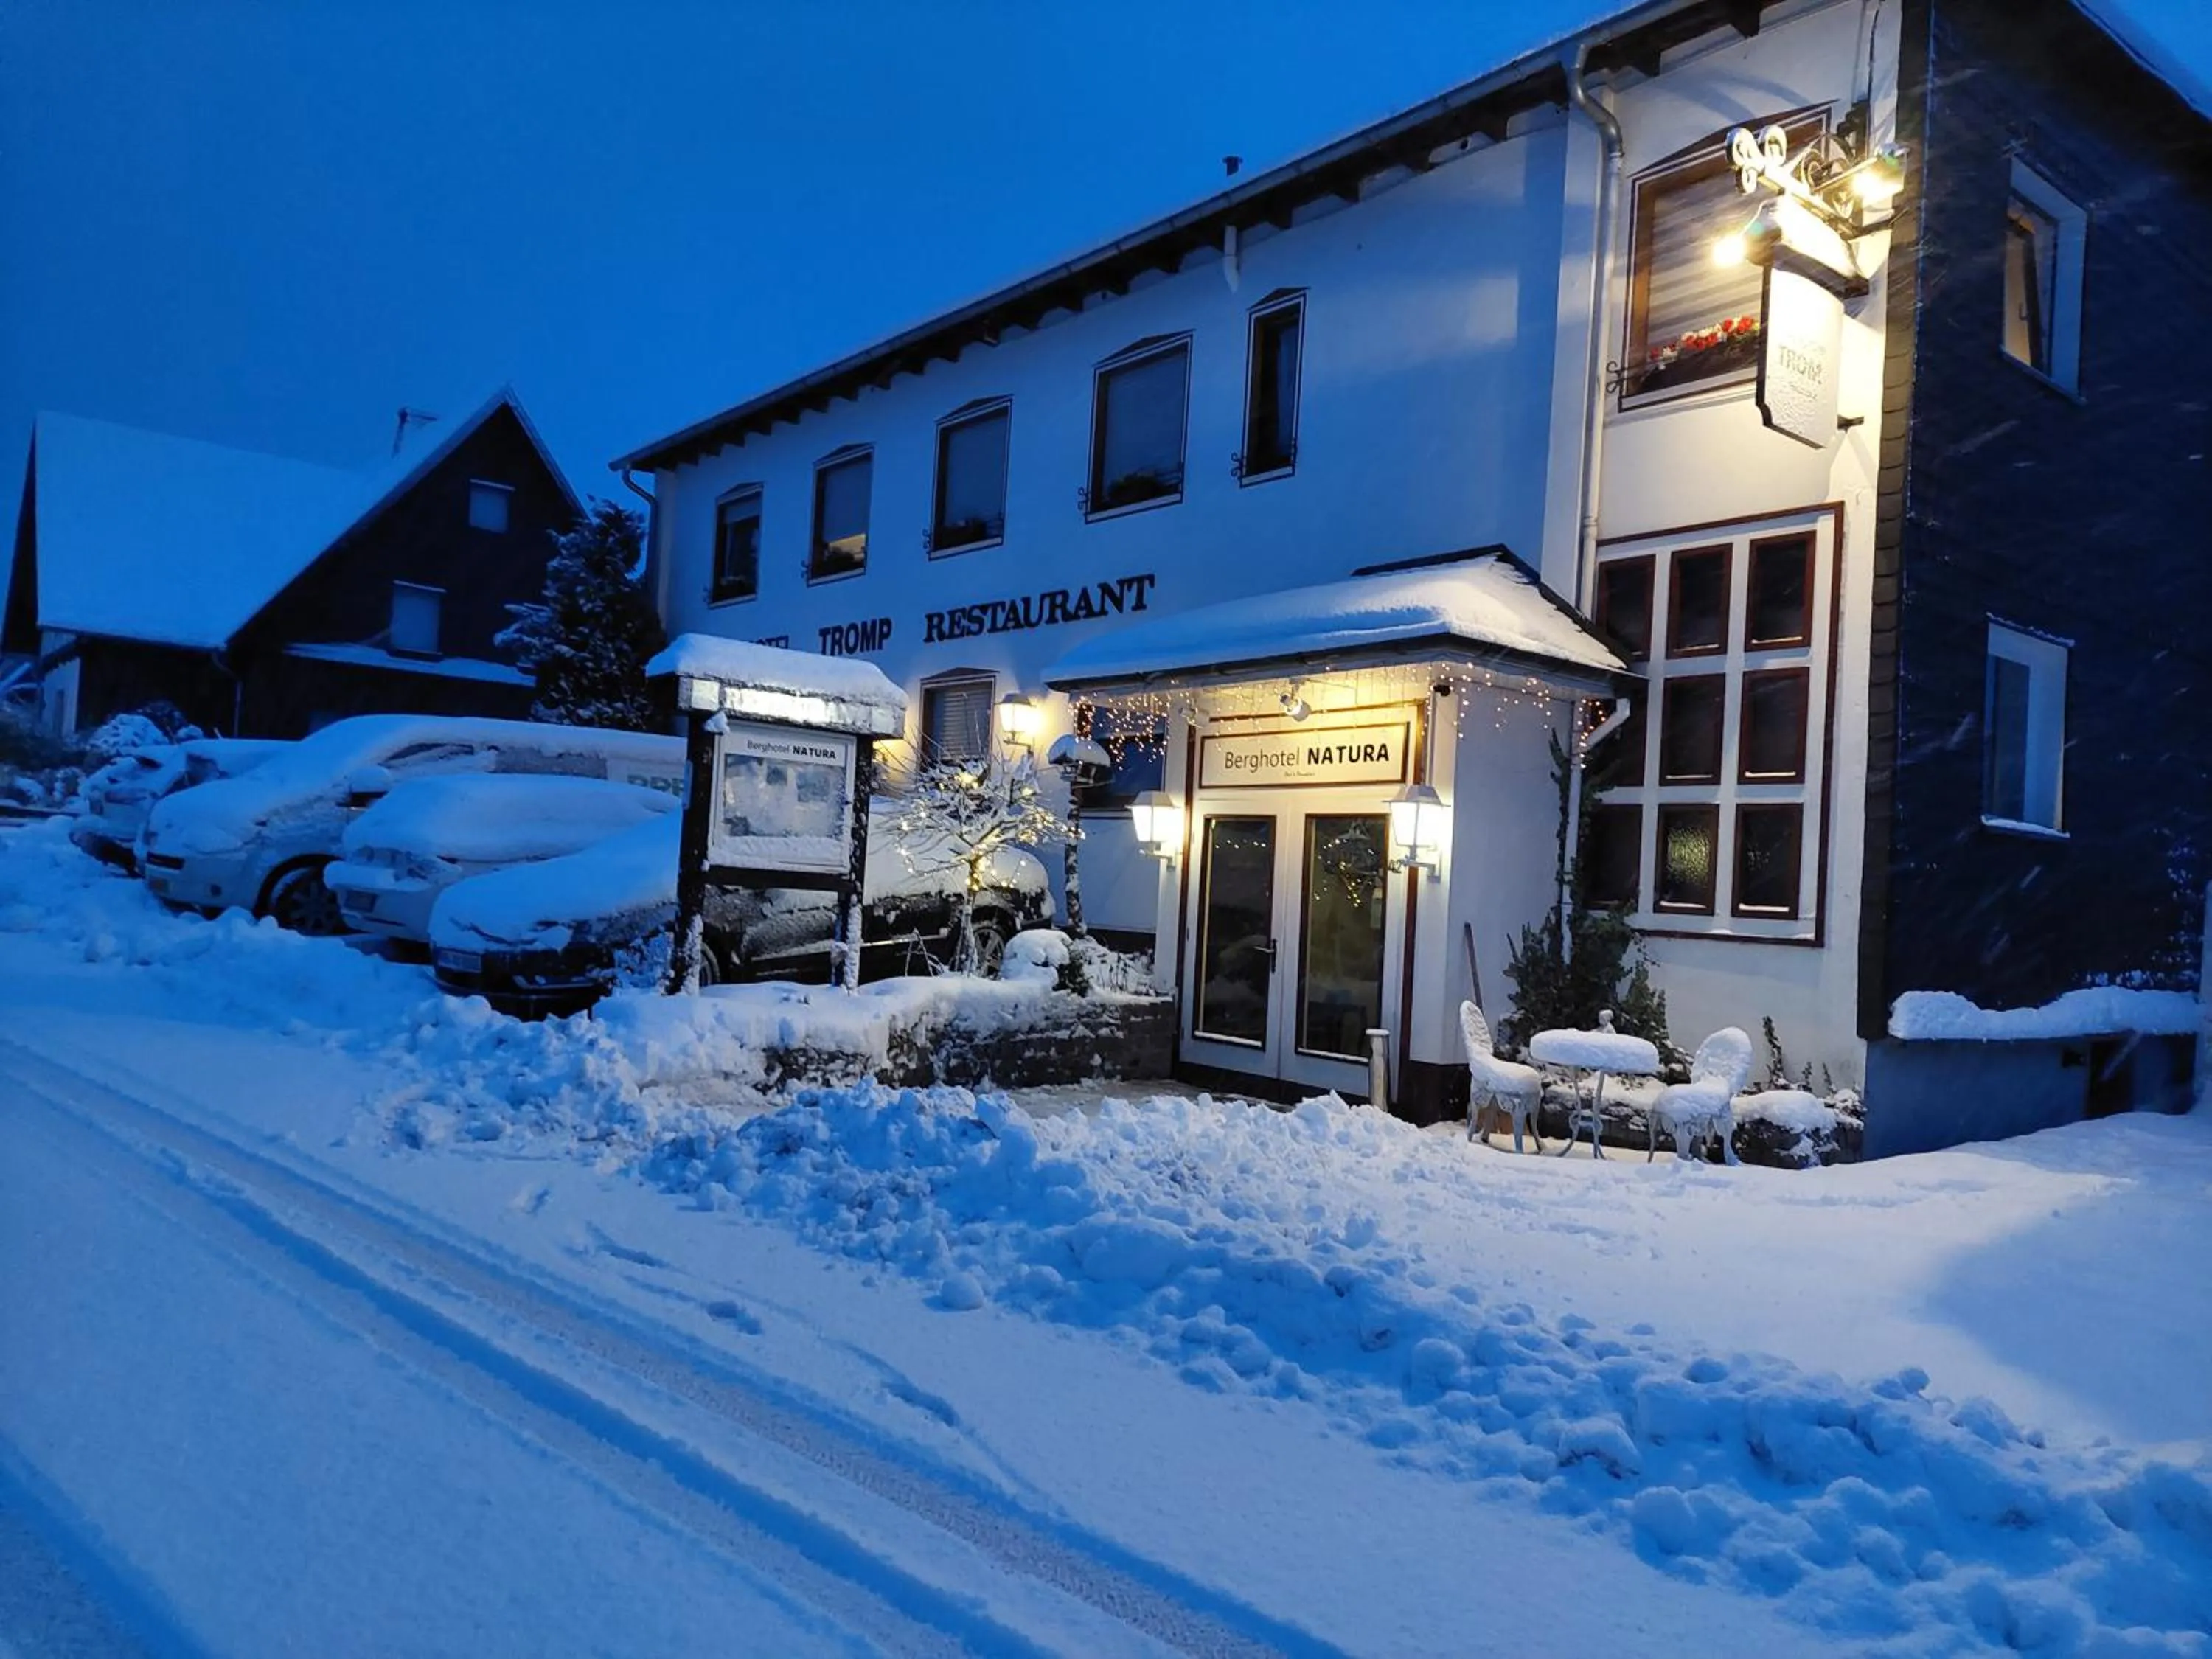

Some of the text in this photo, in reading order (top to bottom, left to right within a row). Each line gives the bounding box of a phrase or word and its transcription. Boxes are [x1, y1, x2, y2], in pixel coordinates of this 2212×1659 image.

[818, 574, 1155, 655] TROMP RESTAURANT
[747, 740, 836, 759] Berghotel NATURA
[1225, 743, 1390, 773] Berghotel NATURA
